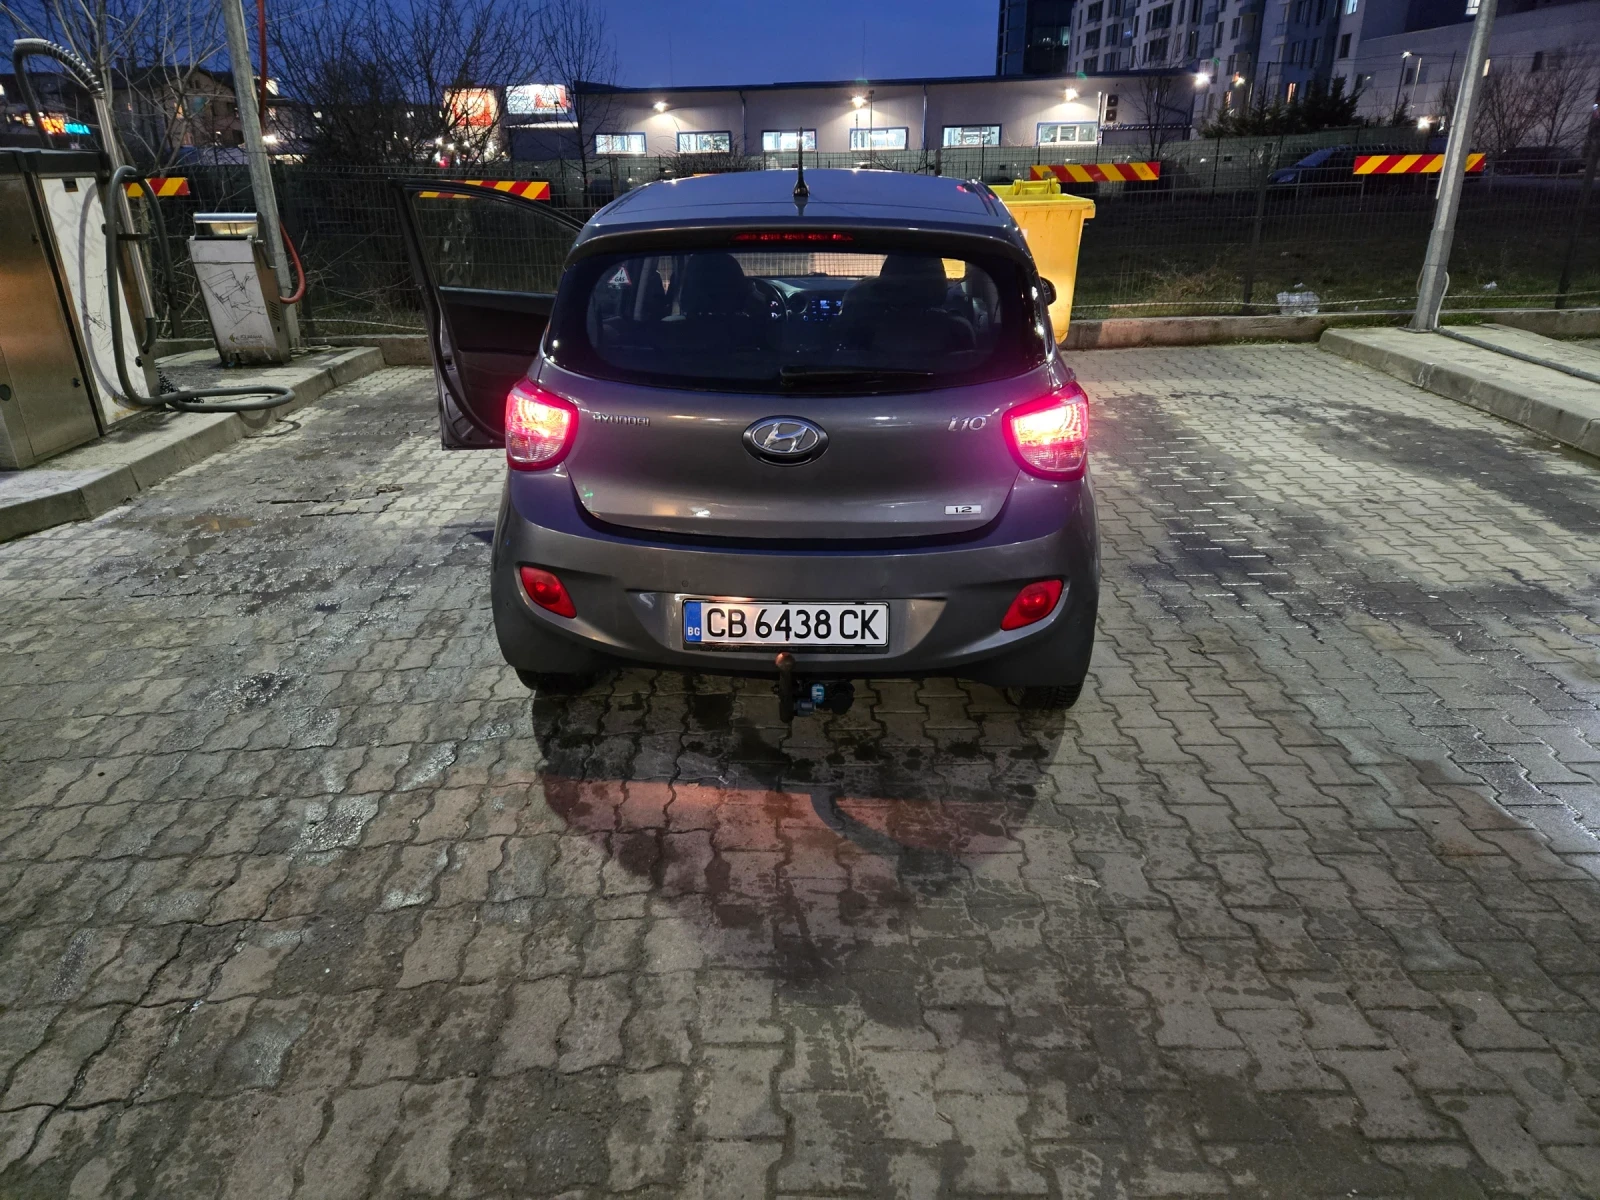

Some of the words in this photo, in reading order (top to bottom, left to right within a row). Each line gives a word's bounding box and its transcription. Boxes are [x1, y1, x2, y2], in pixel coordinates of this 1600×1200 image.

[592, 412, 651, 426] HYUNDAI
[687, 626, 701, 636] BG
[707, 608, 747, 638] CB
[754, 608, 832, 640] 6438
[839, 609, 880, 640] CK
